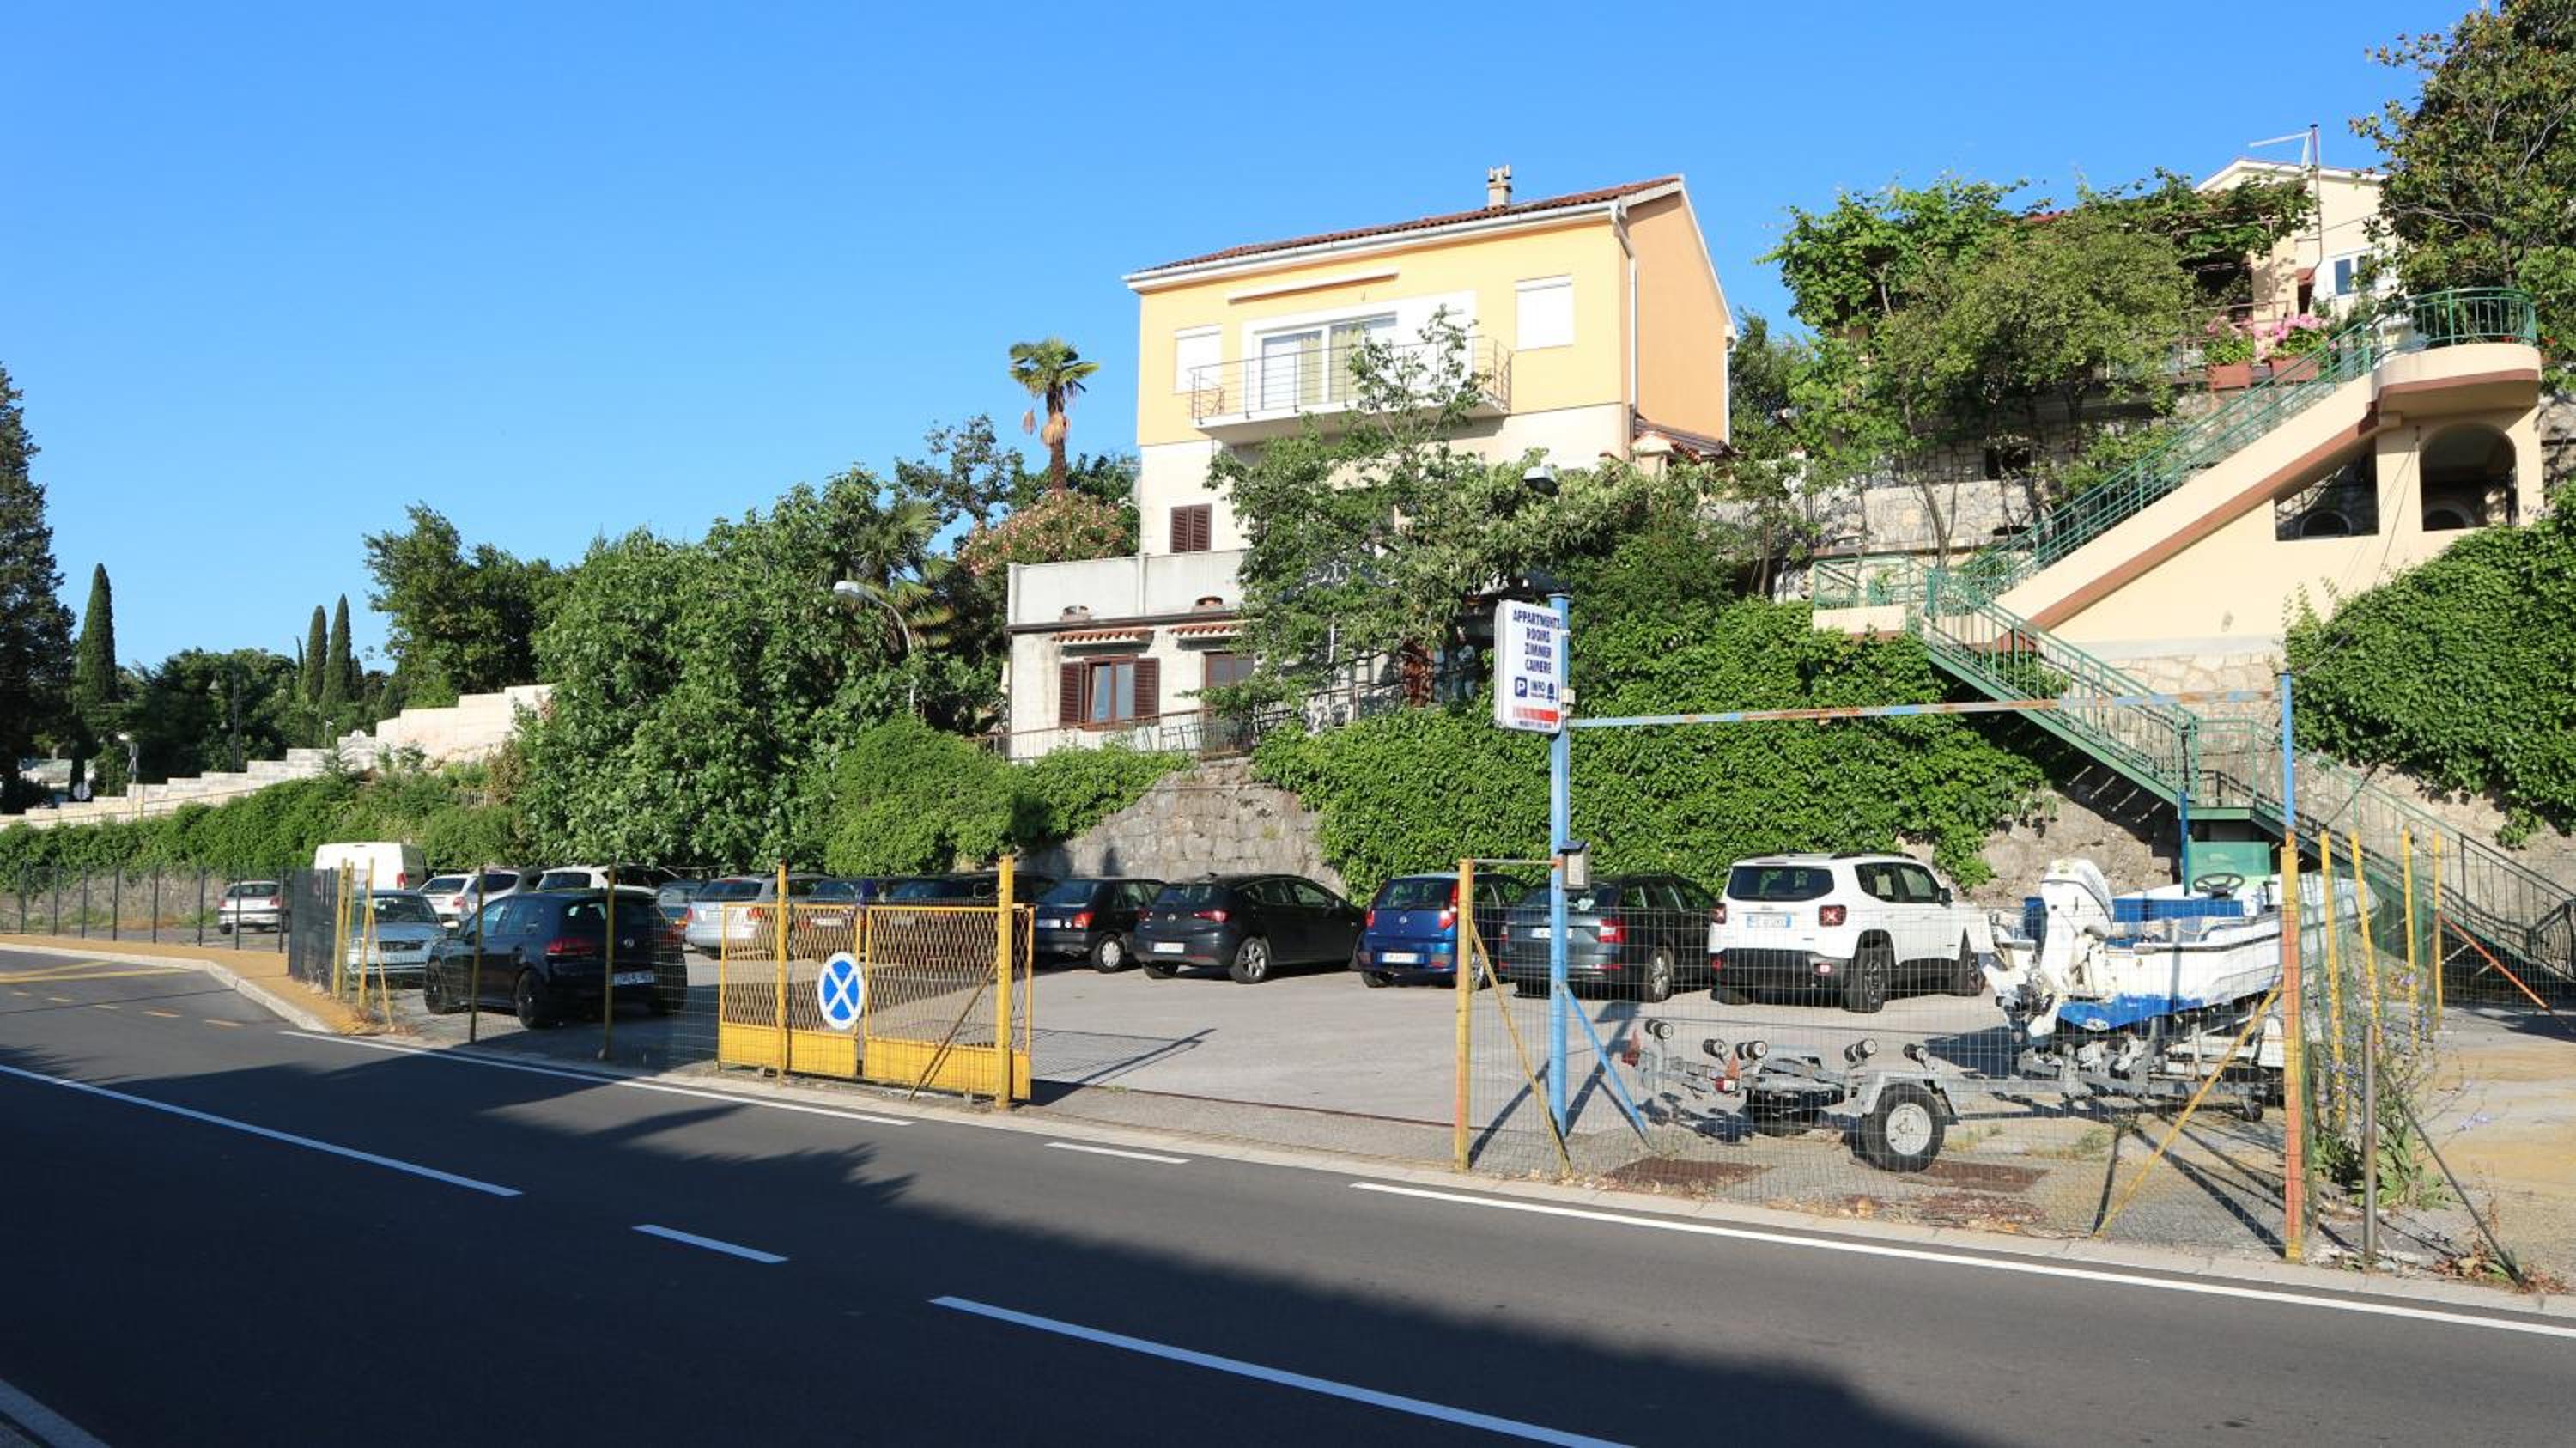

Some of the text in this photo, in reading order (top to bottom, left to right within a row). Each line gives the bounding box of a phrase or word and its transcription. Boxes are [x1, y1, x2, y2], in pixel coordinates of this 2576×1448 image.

[1527, 627, 1550, 643] ROOMS
[1525, 642, 1551, 658] ZIMMER
[1525, 659, 1551, 673] CAMERE
[1530, 680, 1546, 692] INFO
